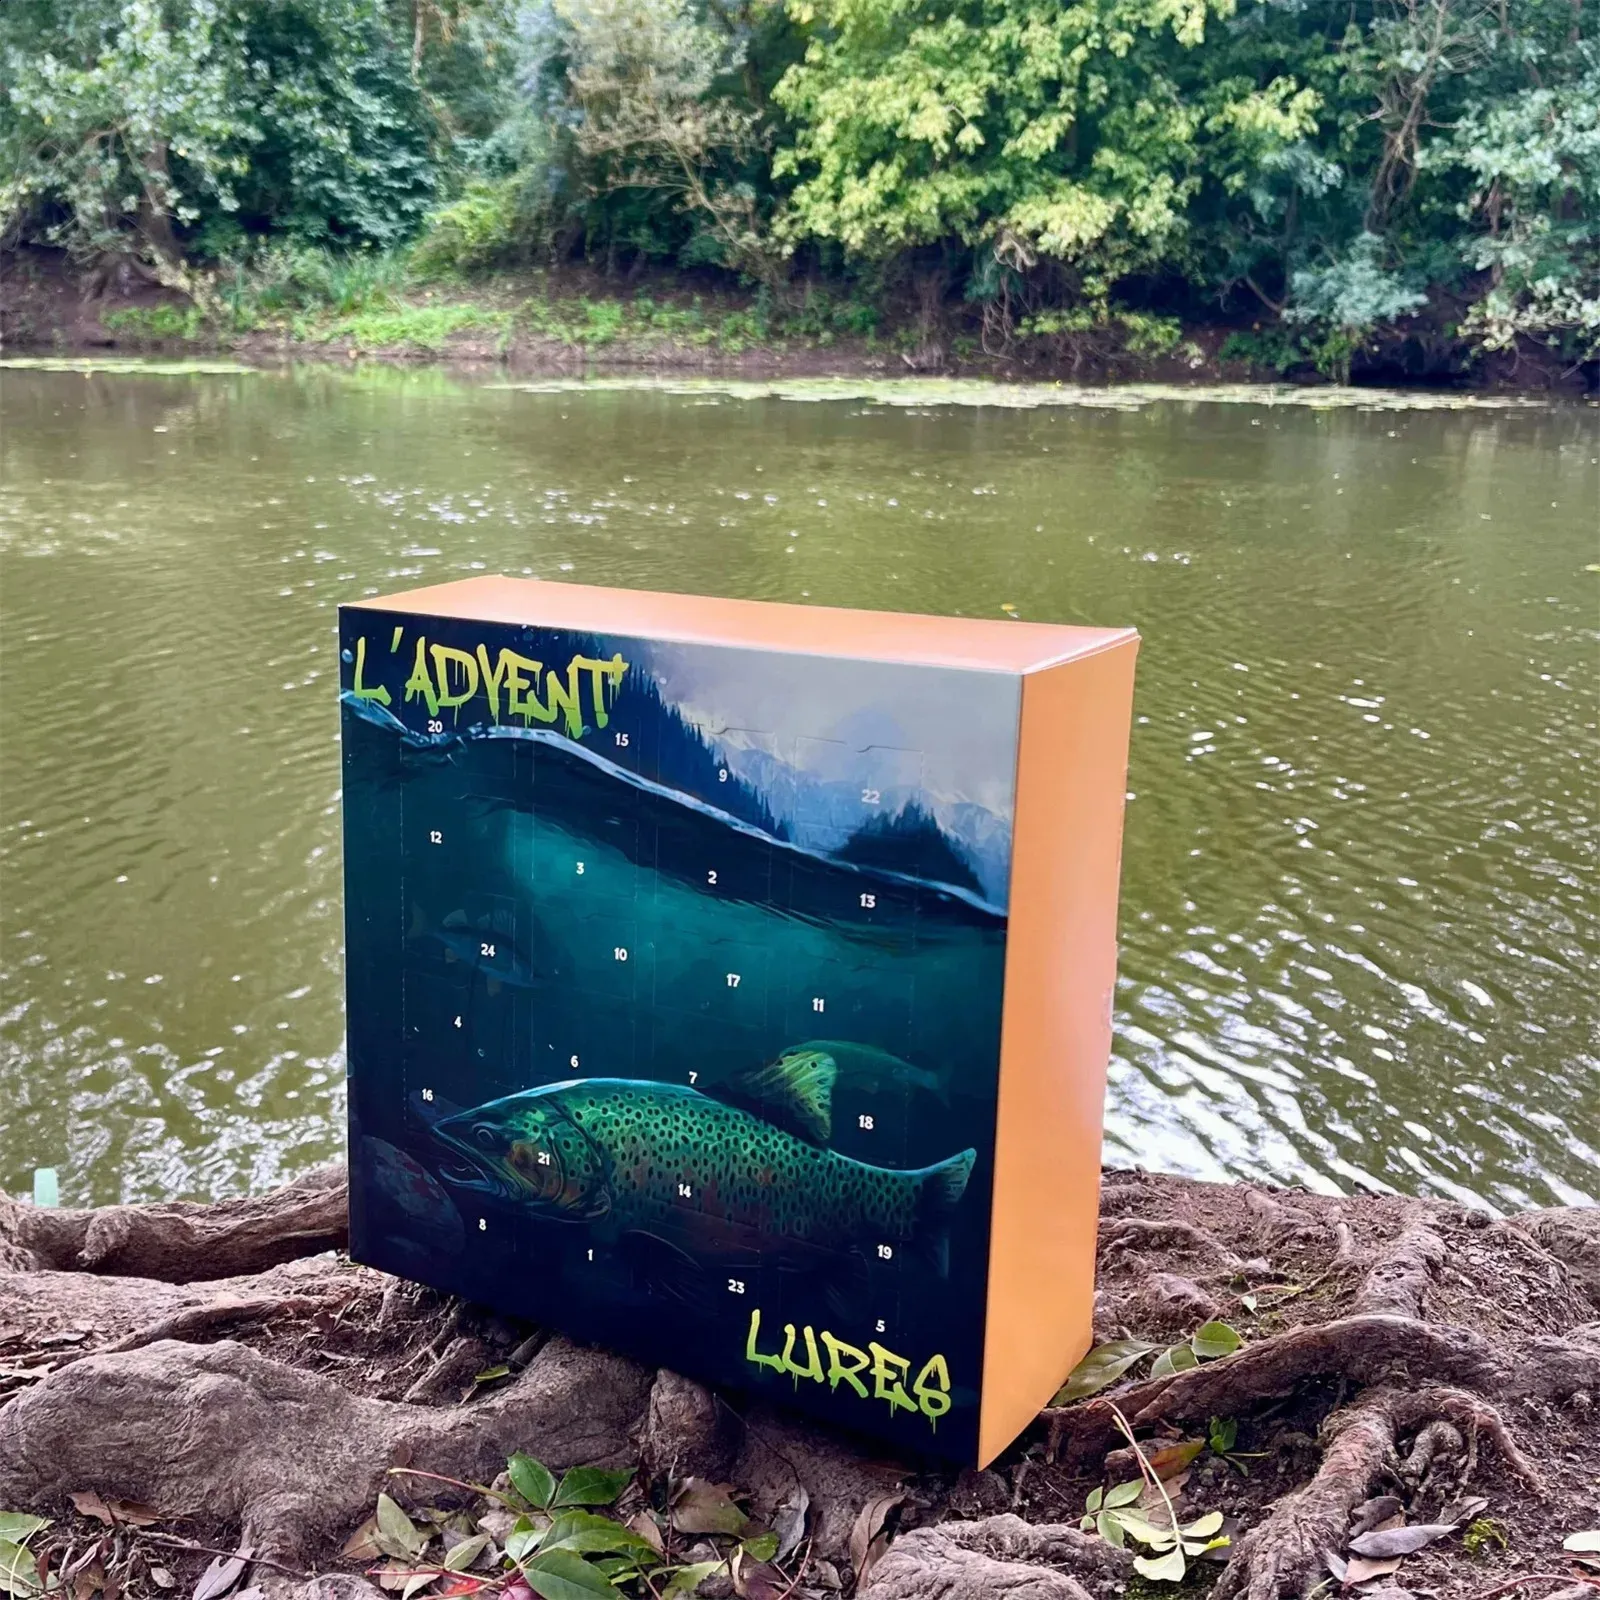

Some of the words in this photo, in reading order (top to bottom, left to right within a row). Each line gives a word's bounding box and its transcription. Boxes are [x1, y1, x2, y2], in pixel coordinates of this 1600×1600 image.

[354, 627, 628, 739] L'ADVENT
[428, 720, 443, 733] 20
[615, 733, 629, 747] 15
[719, 769, 727, 782] 9
[862, 789, 880, 804] 22
[430, 831, 442, 844] 12
[576, 862, 584, 875] 3
[708, 870, 717, 884] 2
[860, 893, 875, 908] 13
[481, 943, 495, 957] 24
[614, 947, 627, 961] 10
[726, 973, 741, 987] 17
[813, 998, 824, 1012] 11
[454, 1016, 462, 1028] 4
[570, 1055, 579, 1068] 6
[689, 1071, 698, 1084] 7
[422, 1088, 433, 1101] 16
[859, 1115, 874, 1130] 18
[537, 1151, 550, 1166] 21
[678, 1183, 692, 1198] 14
[479, 1218, 487, 1231] 8
[588, 1249, 593, 1261] 1
[877, 1244, 892, 1260] 19
[728, 1279, 745, 1294] 23
[875, 1319, 885, 1332] 5
[746, 1308, 951, 1427] LURES
